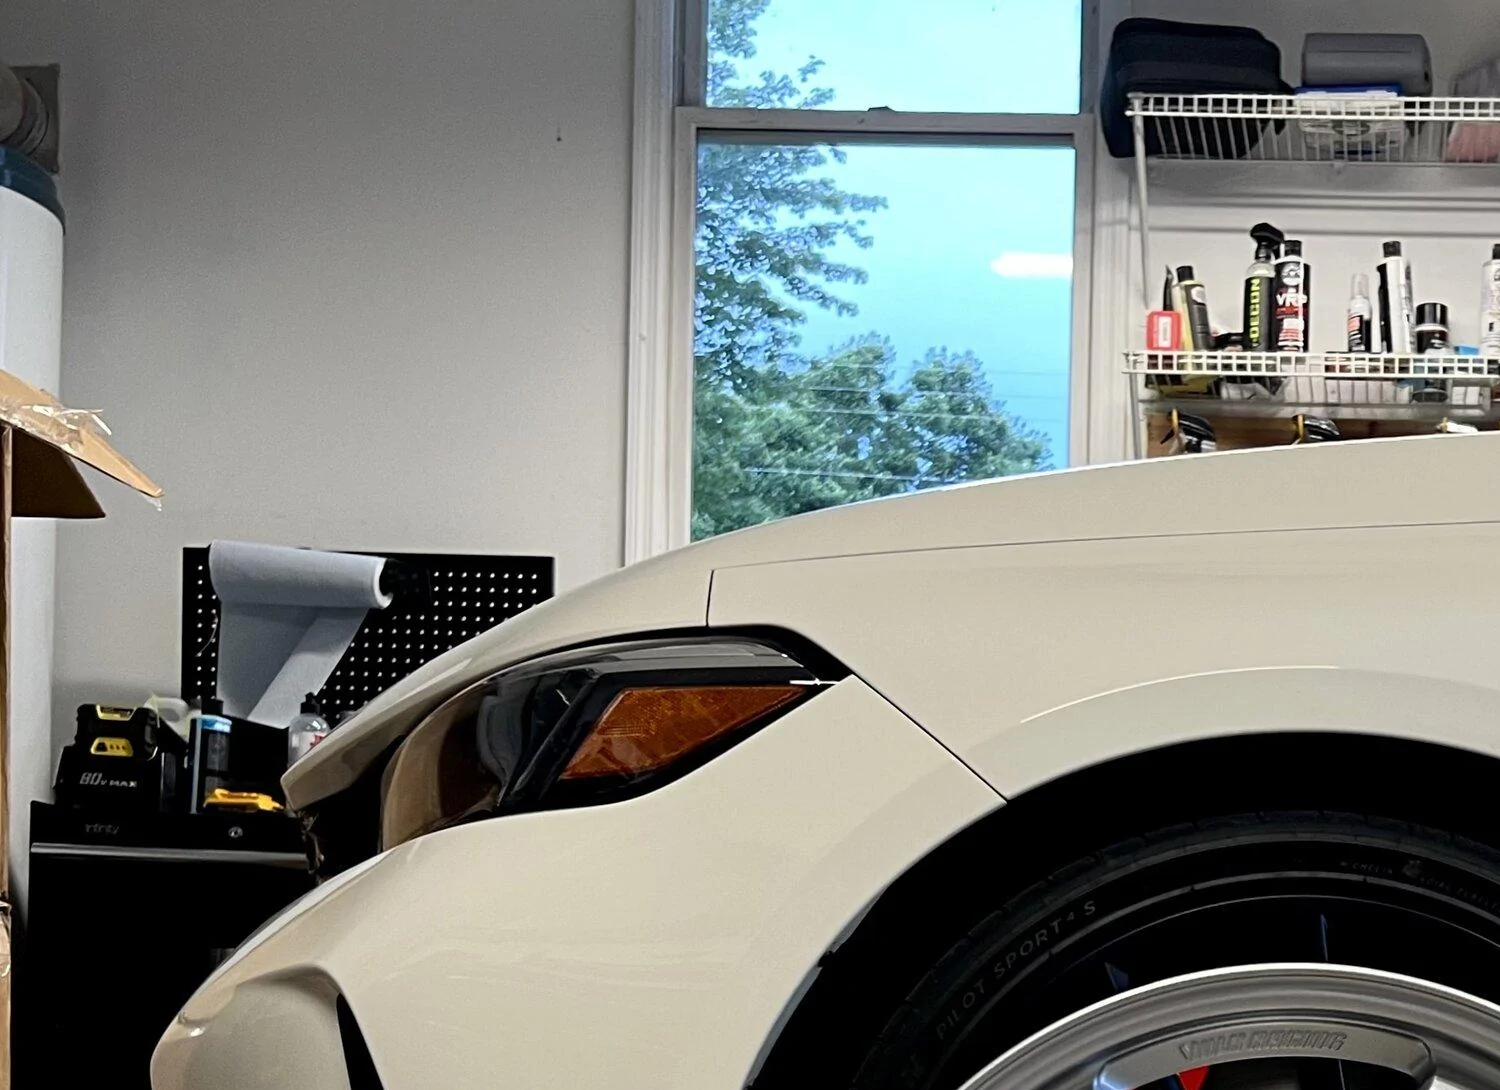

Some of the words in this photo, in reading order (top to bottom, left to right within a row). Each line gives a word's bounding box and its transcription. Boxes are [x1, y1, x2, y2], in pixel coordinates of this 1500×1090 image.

[936, 979, 985, 1040] PILOT
[994, 919, 1061, 979] SPORT
[1084, 901, 1096, 916] S
